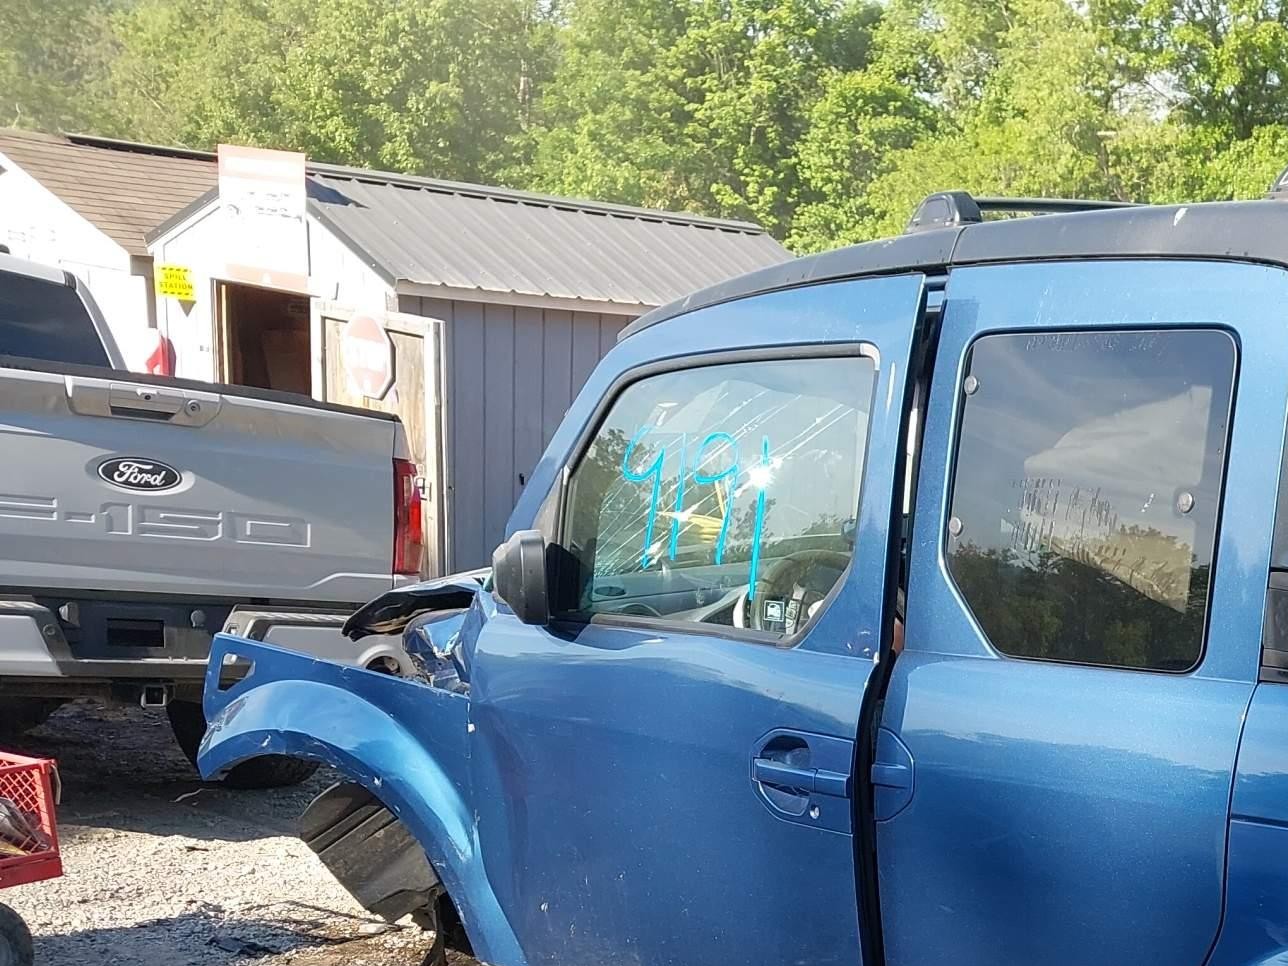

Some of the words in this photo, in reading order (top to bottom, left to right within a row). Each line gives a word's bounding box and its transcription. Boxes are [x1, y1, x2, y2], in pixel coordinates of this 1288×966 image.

[164, 273, 187, 281] SPILL
[159, 281, 193, 290] STATION
[113, 460, 166, 487] Ford
